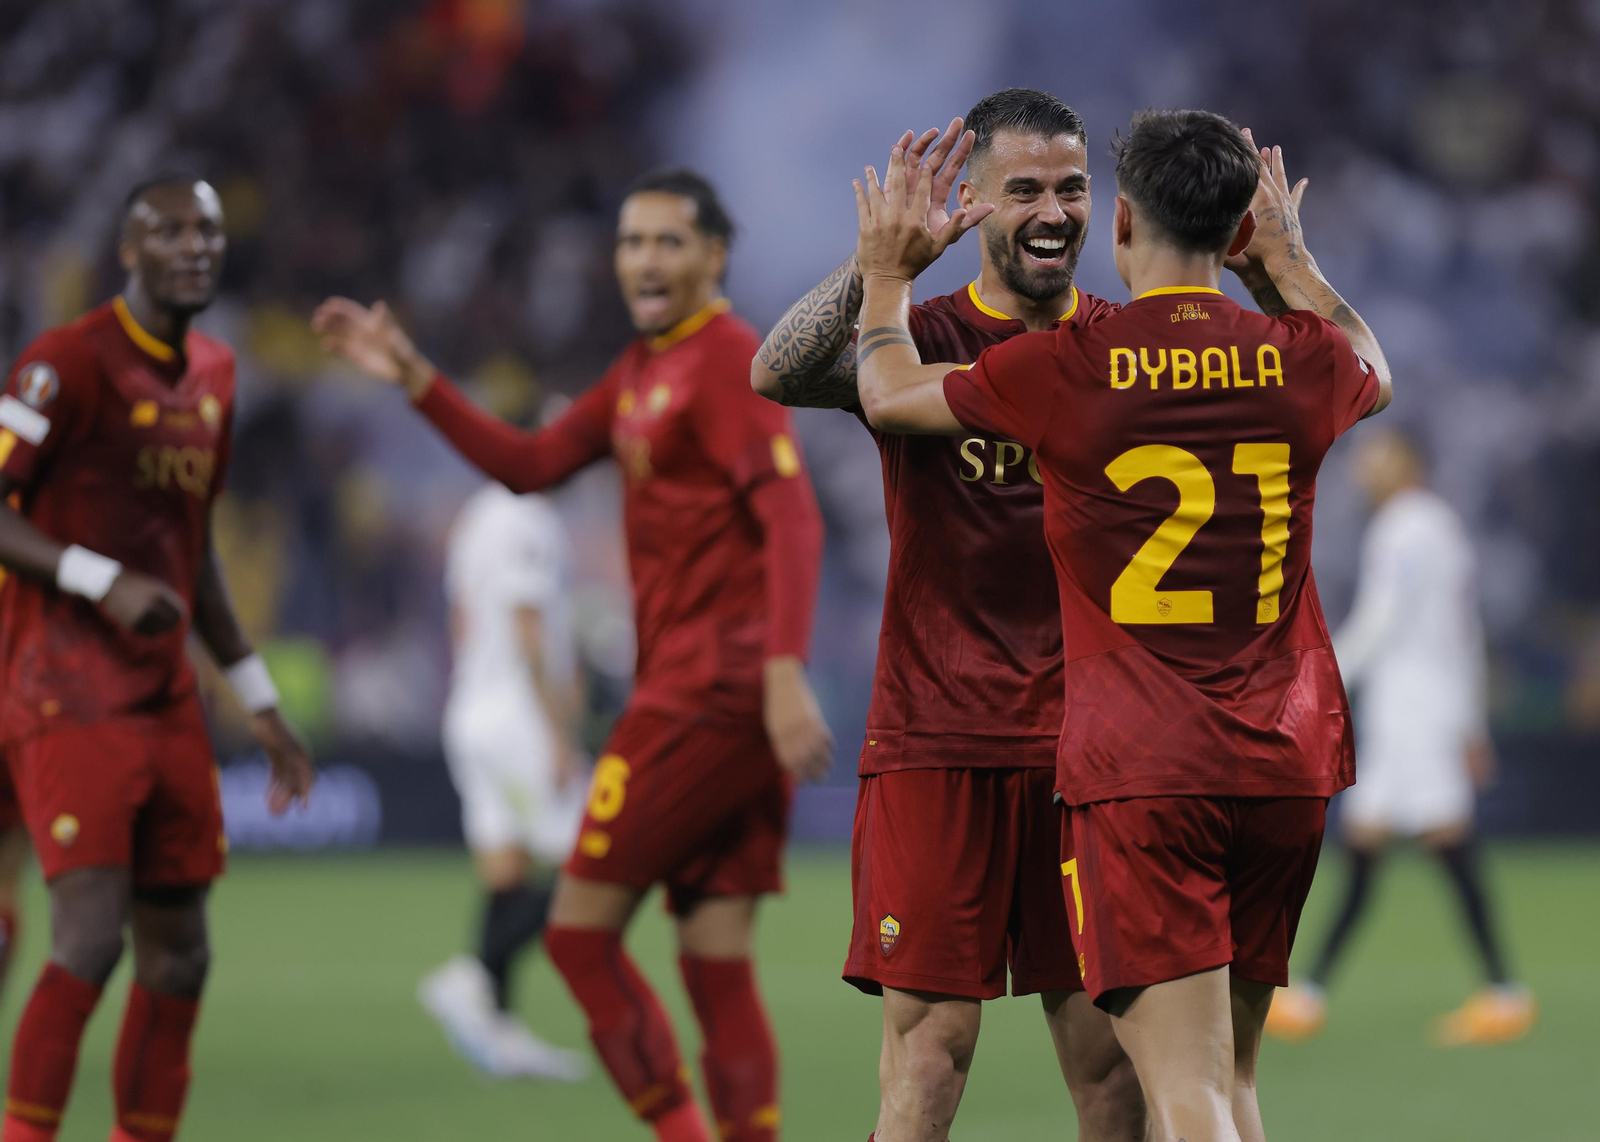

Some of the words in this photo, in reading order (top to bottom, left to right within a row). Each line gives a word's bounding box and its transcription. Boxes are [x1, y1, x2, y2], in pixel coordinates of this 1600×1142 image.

[1170, 312, 1181, 323] DI
[1182, 311, 1211, 321] ROMA
[1177, 303, 1202, 313] FIGLI
[1109, 343, 1284, 390] DYBALA
[1104, 442, 1292, 624] 21
